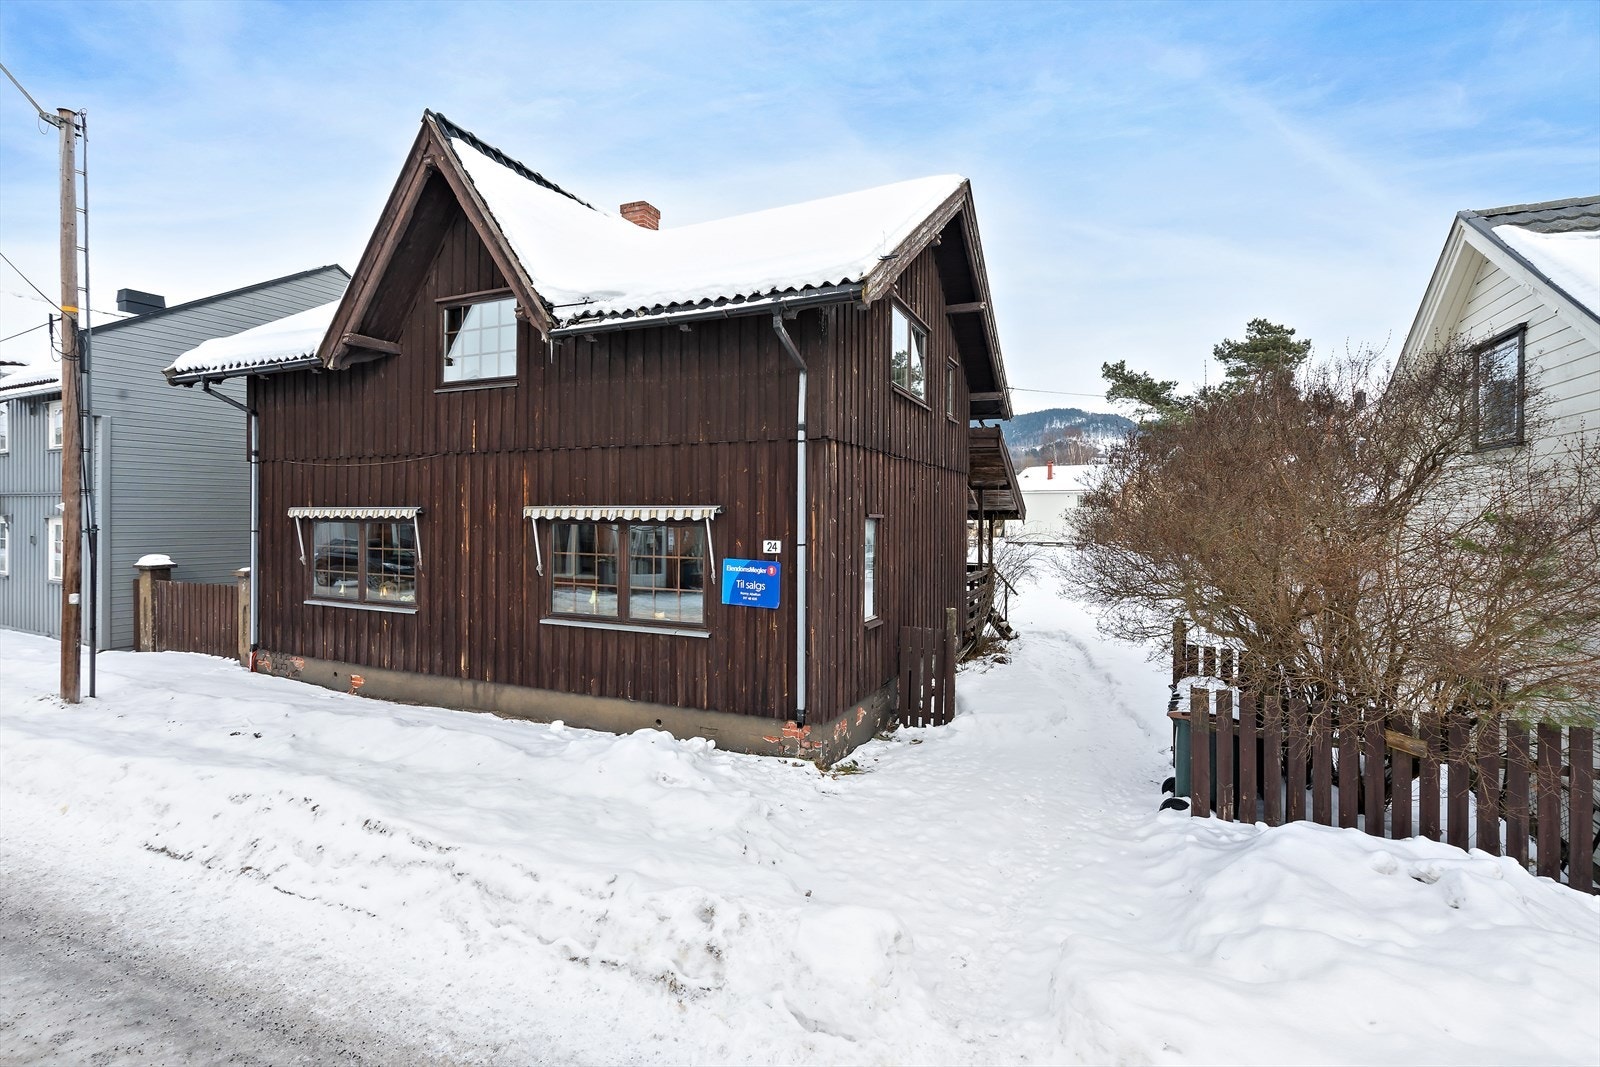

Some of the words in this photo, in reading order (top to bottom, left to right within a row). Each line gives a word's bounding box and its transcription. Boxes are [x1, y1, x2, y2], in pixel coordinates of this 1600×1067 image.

[767, 542, 777, 552] 24
[736, 579, 744, 589] Til
[745, 581, 765, 592] salgs
